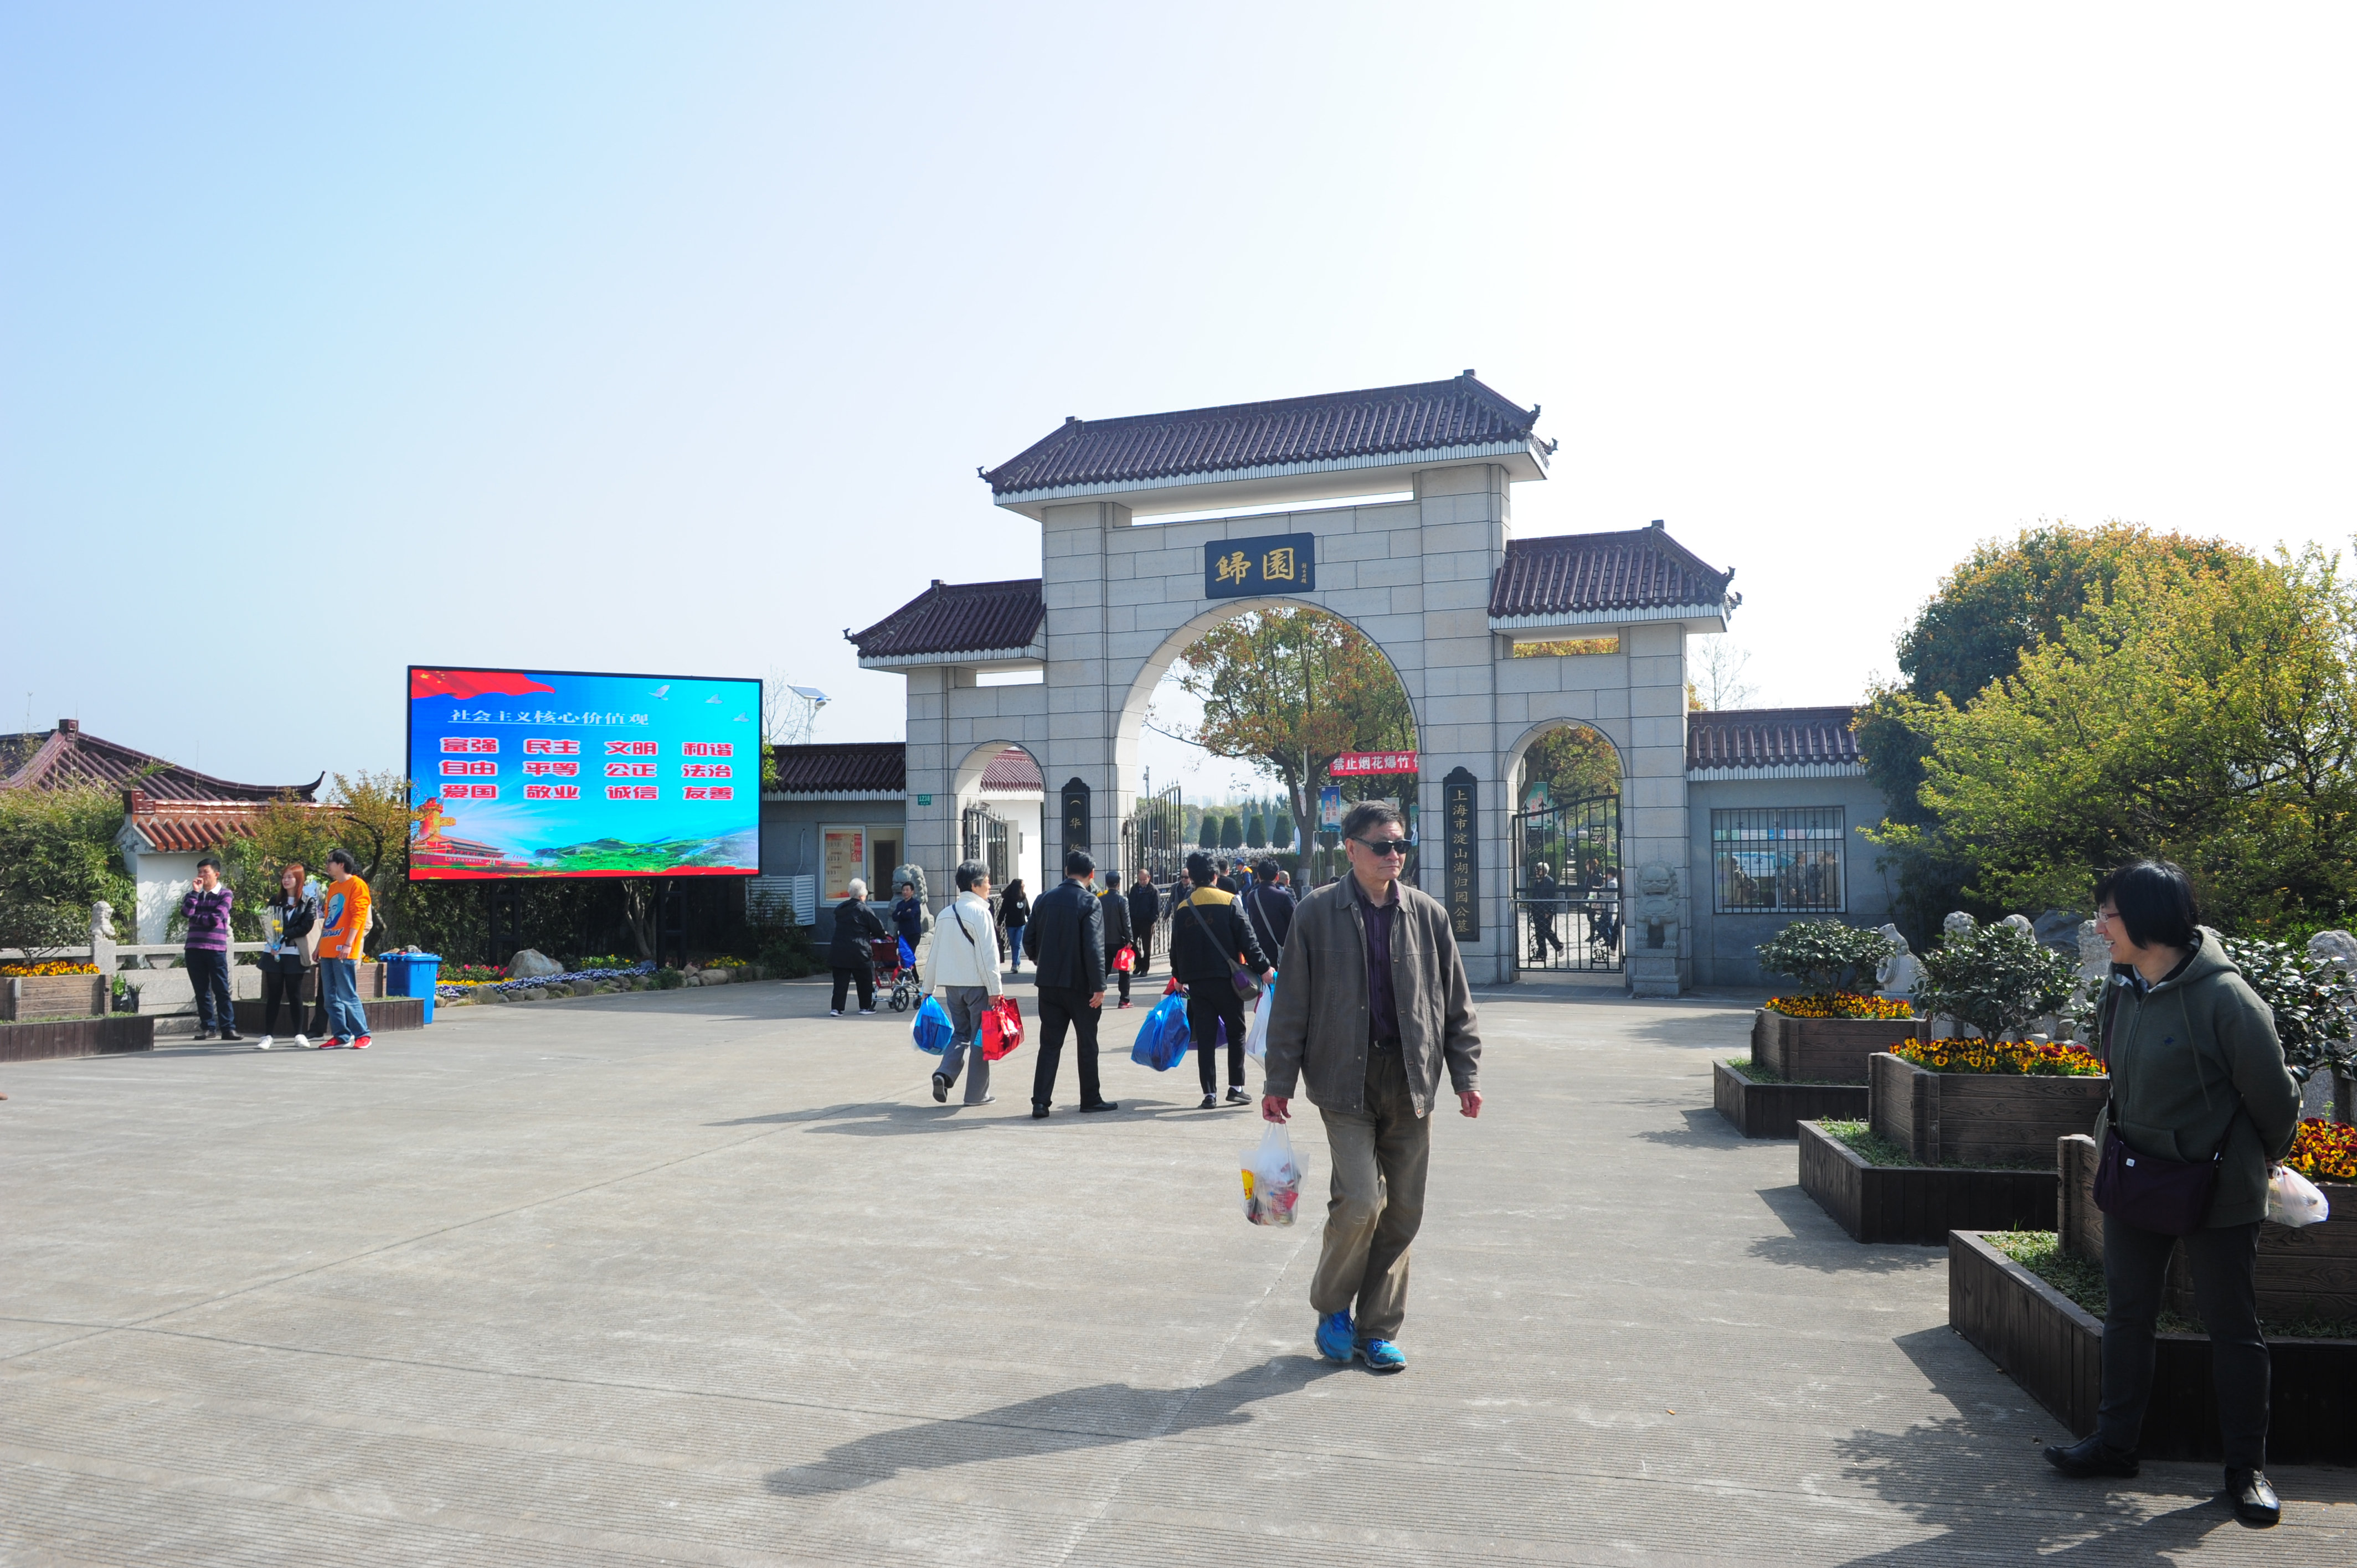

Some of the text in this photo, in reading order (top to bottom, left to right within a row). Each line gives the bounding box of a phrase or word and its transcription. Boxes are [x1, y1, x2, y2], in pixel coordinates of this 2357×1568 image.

[450, 709, 649, 725] 社会主义核心价值观
[442, 738, 732, 756] 富强 民主 文明 和谐
[442, 761, 732, 777] 自由 平等 公正 法治
[1332, 755, 1409, 771] 禁止烟花爆竹
[442, 785, 732, 800] 爱国 敬业 诚信 友善
[1452, 790, 1470, 932] 上海市淀山湖归园公墓
